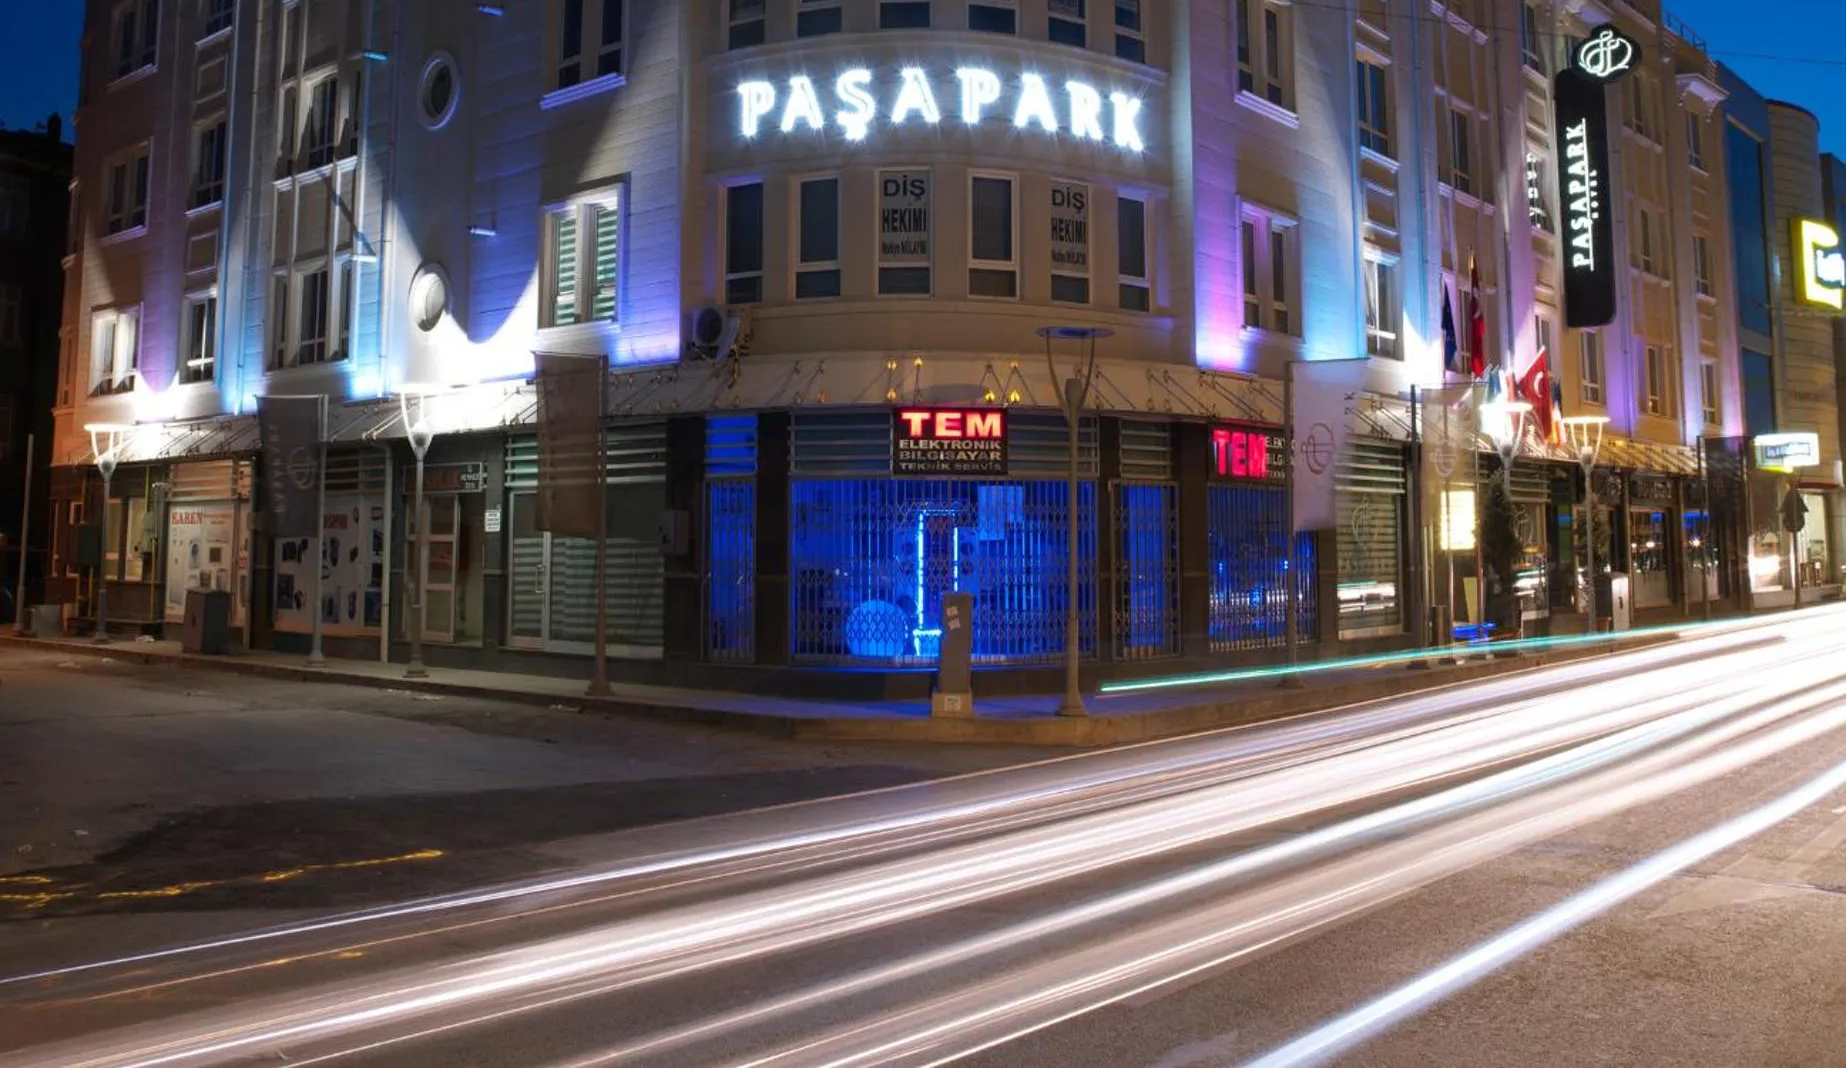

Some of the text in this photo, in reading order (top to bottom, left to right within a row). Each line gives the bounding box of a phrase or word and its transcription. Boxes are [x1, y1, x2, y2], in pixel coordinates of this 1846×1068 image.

[883, 175, 926, 201] DİŞ
[1051, 186, 1085, 213] DİŞ
[901, 412, 1002, 437] TEM
[1212, 430, 1267, 478] TEM
